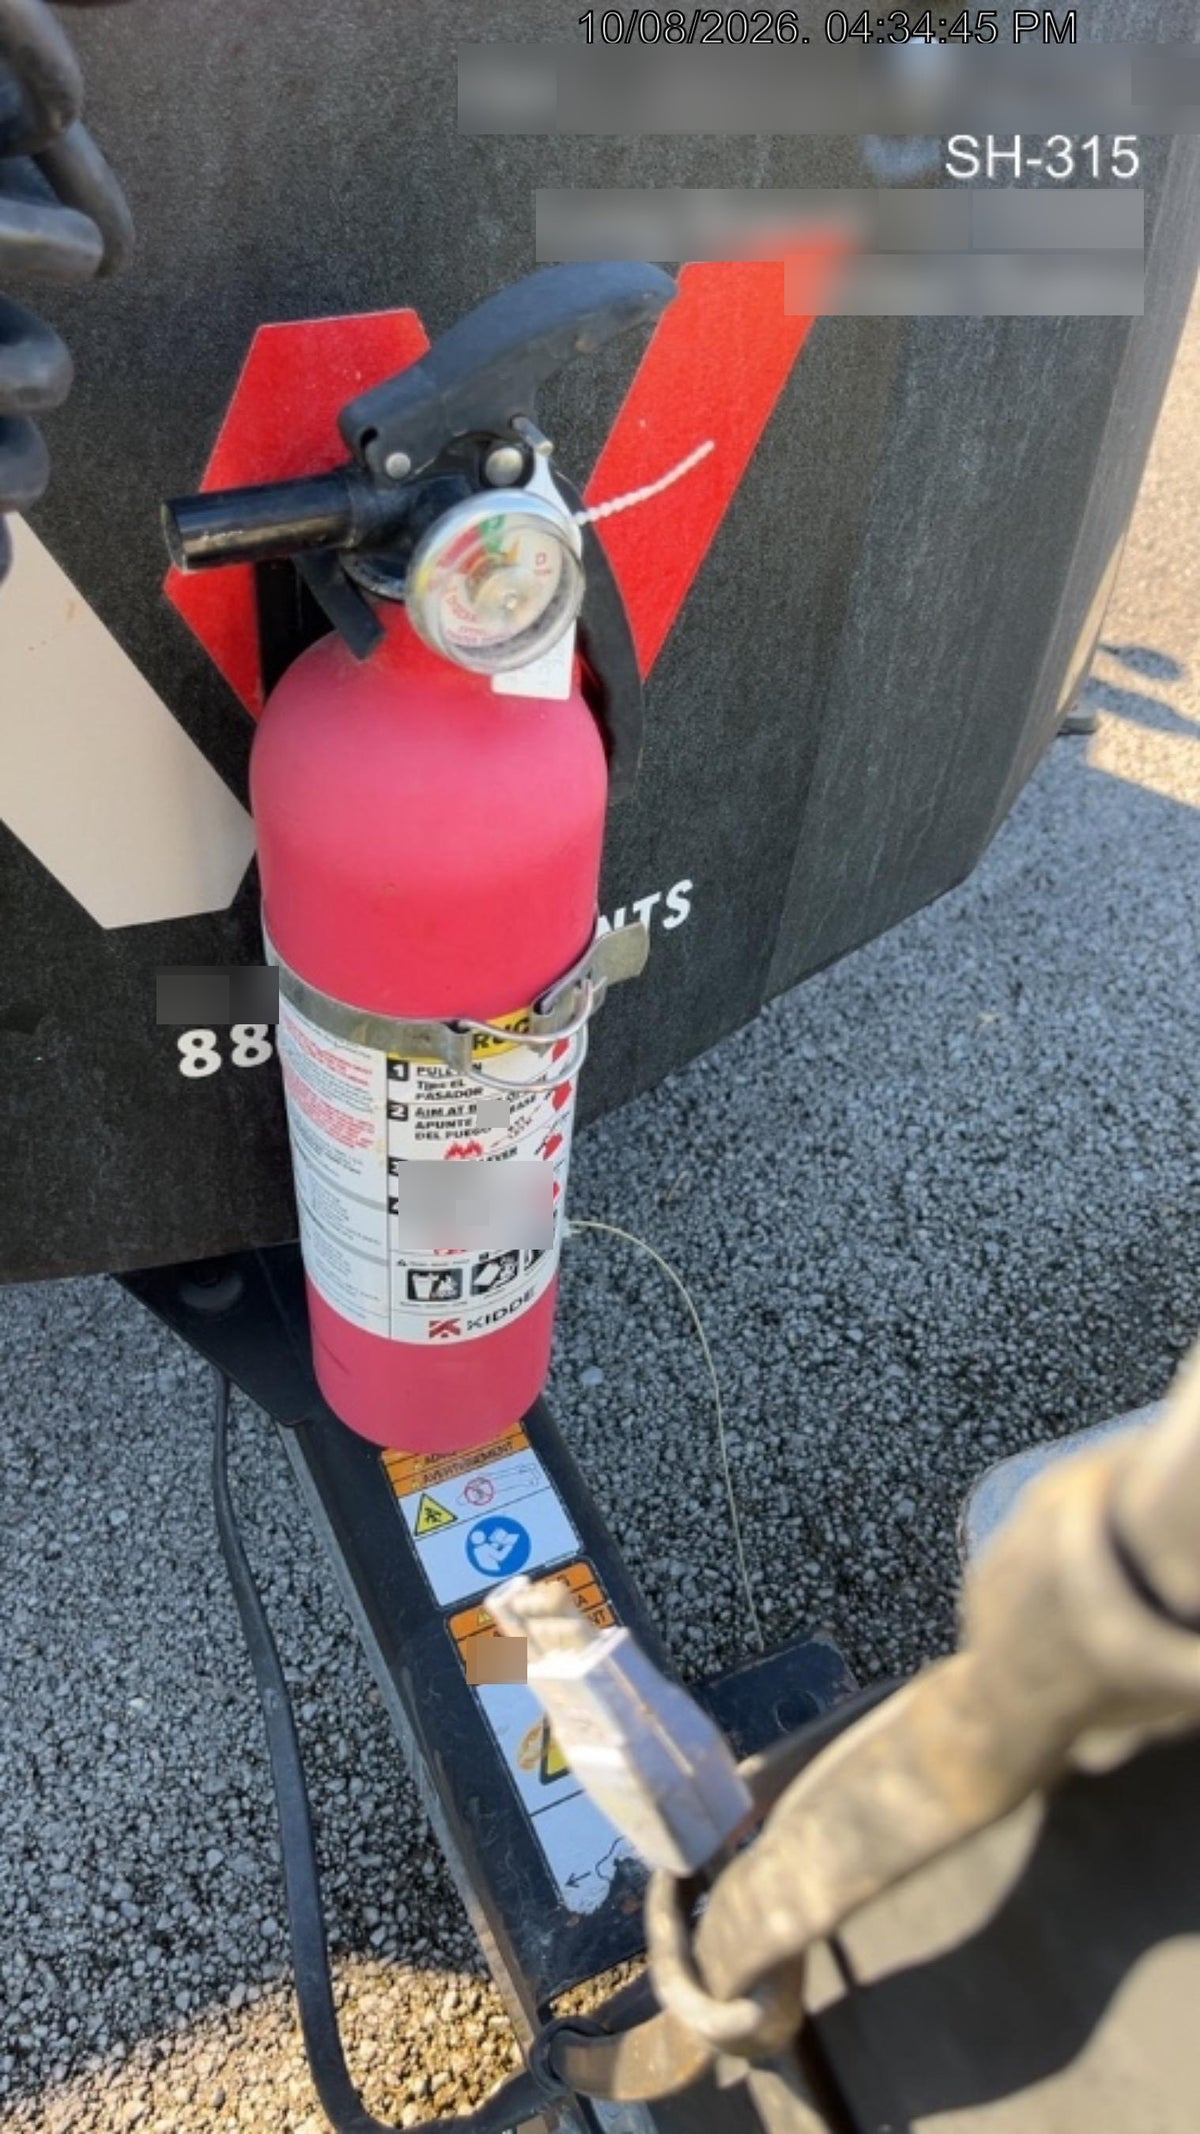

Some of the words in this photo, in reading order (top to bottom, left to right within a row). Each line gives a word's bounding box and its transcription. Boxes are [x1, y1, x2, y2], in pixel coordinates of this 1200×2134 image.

[415, 1087, 484, 1101] PASADOR
[414, 1118, 473, 1130] APUNTE
[466, 1286, 536, 1332] KIDDE
